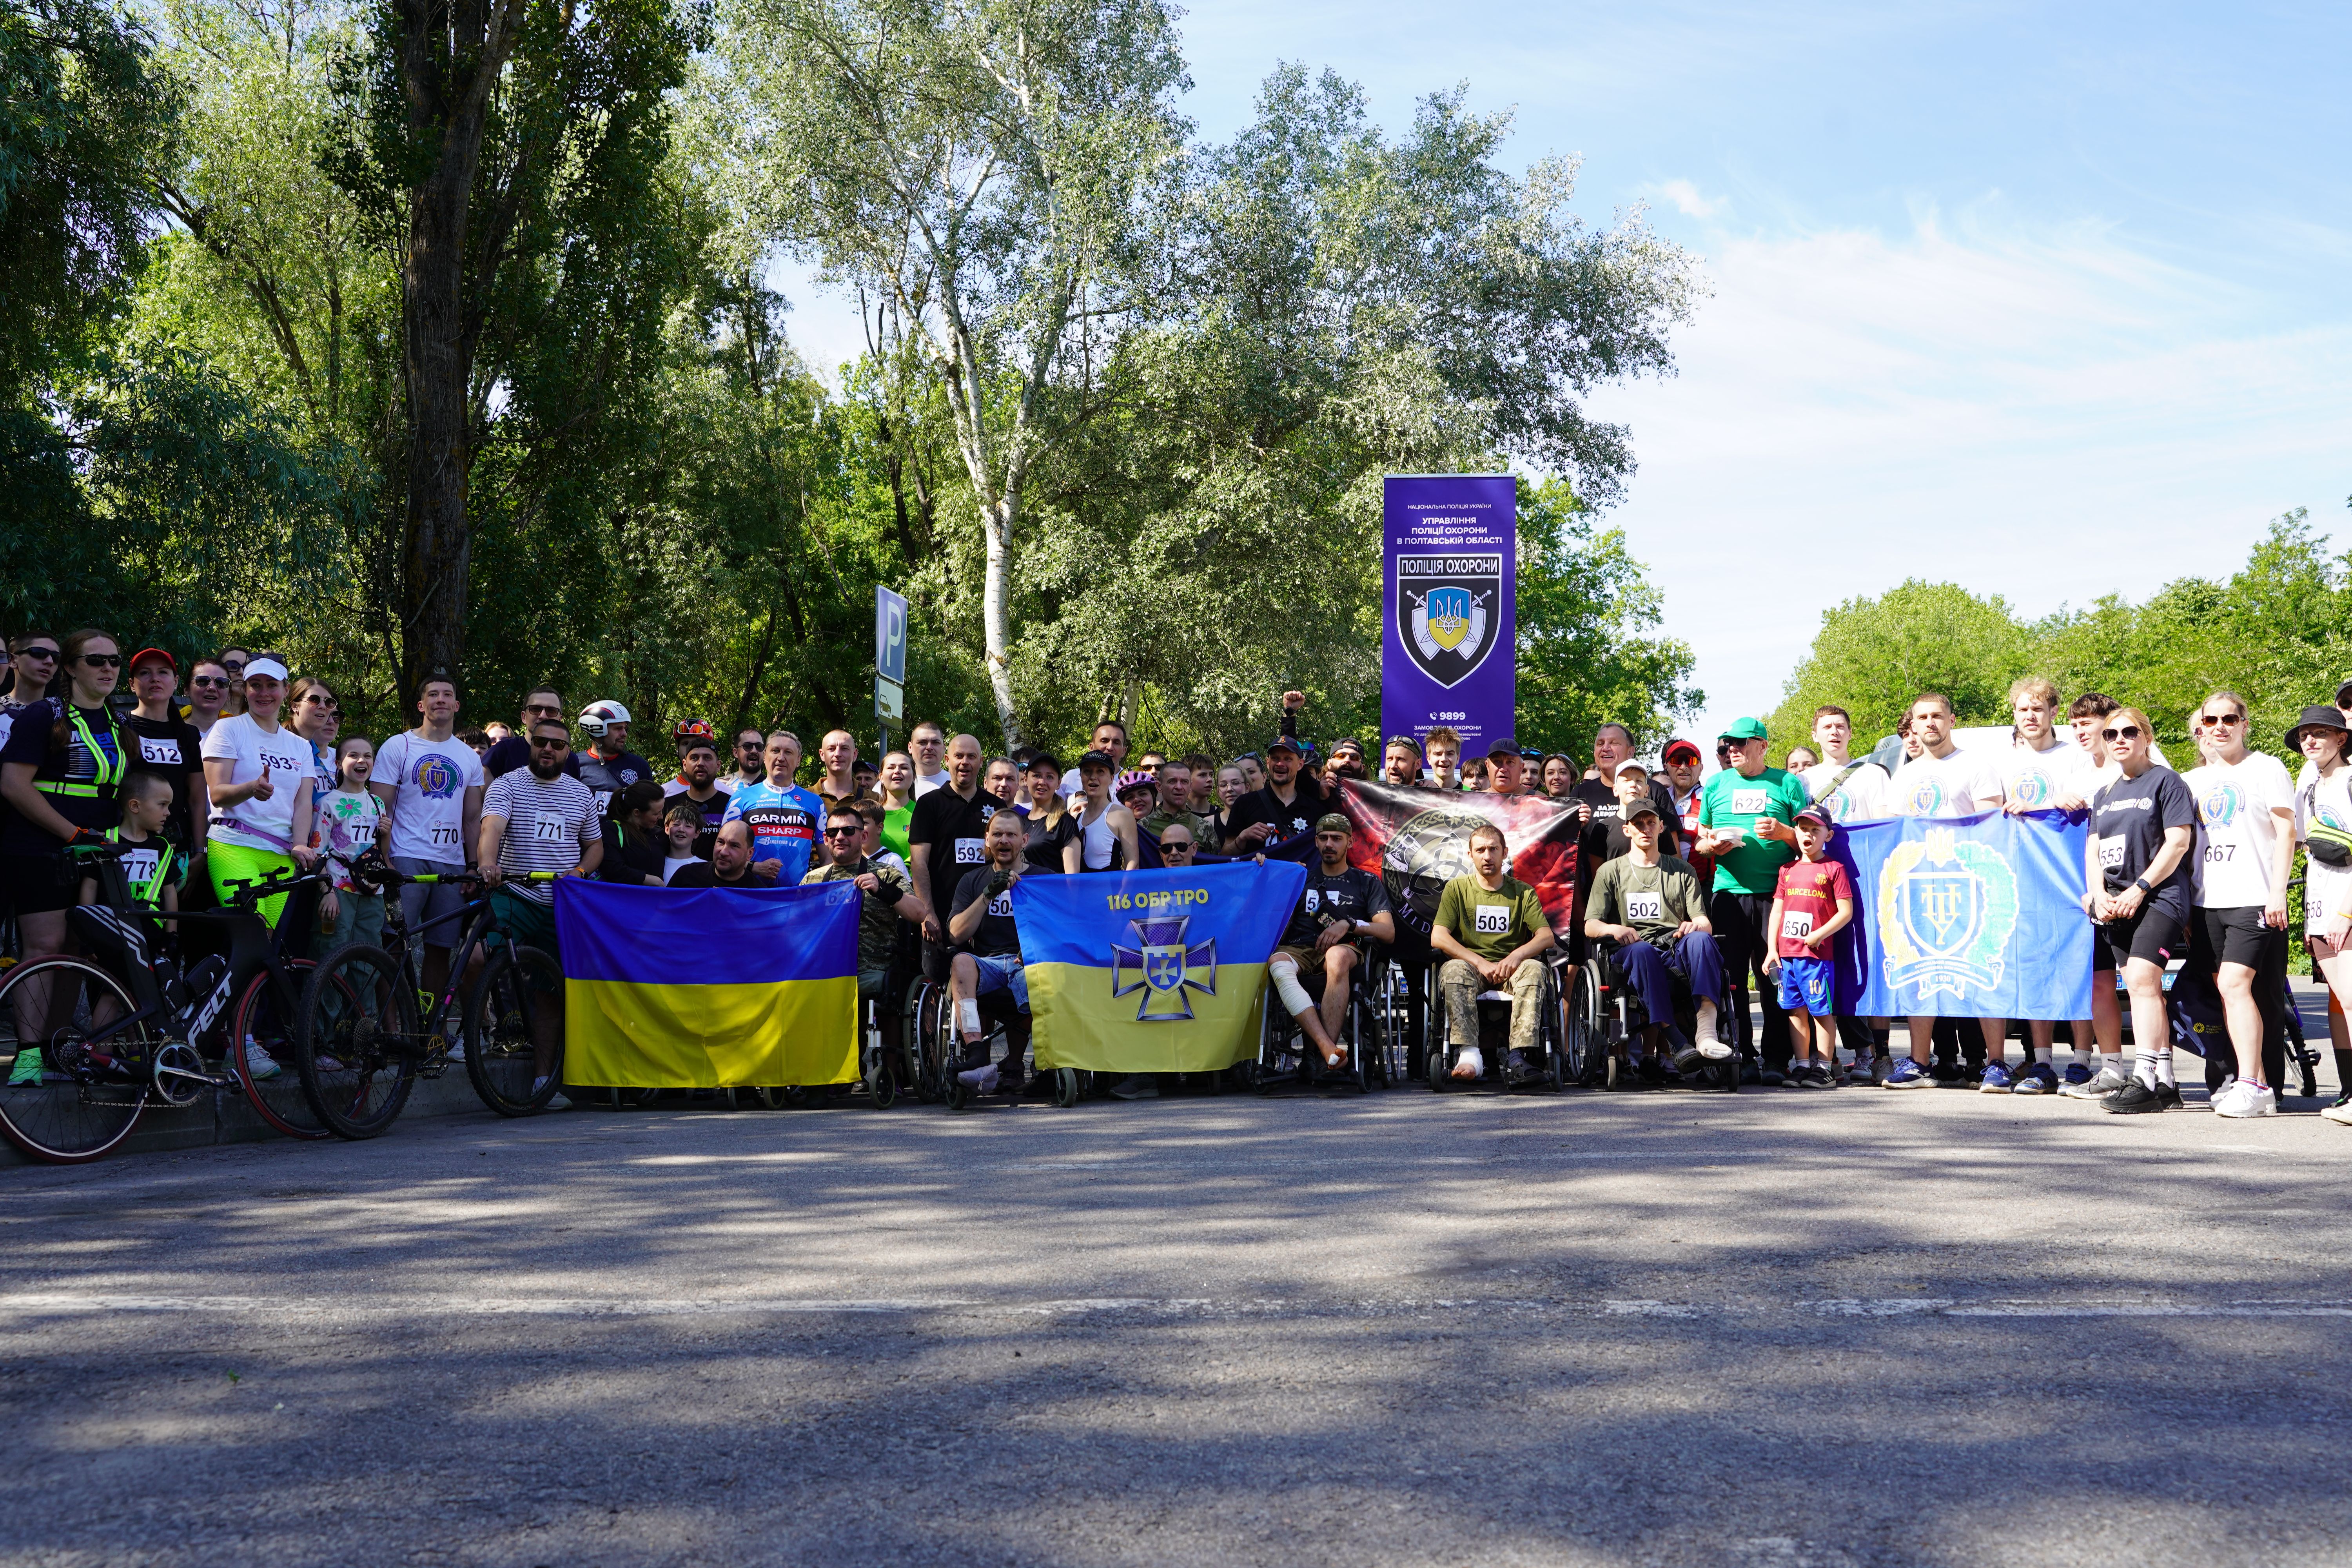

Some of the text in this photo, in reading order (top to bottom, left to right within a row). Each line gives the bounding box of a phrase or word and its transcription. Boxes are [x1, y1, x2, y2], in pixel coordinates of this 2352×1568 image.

[1412, 526, 1443, 535] ПОЛІЦІЇ
[1401, 559, 1497, 575] ПОЛІЦІЯ ОХОРОНИ
[887, 600, 902, 668] P
[1439, 711, 1466, 720] 9899
[144, 746, 180, 762] 512
[260, 753, 292, 770] 593
[1735, 798, 1763, 810] 622
[749, 814, 807, 825] GARMIN
[351, 825, 377, 841] 774
[431, 828, 458, 844] 770
[537, 822, 561, 839] 771
[757, 826, 802, 835] SHARP
[765, 837, 788, 846] BARRACUDA
[957, 847, 984, 862] 592
[2101, 847, 2123, 866] 553
[2205, 845, 2236, 862] 667
[123, 861, 157, 880] 778
[1107, 888, 1209, 910] 116 ОБР ТРО
[1787, 888, 1827, 899] BARCELONA
[1630, 902, 1659, 917] 502
[2306, 900, 2322, 919] 658
[1477, 915, 1507, 931] 503
[1785, 921, 1809, 937] 650
[1809, 979, 1821, 995] 10
[187, 970, 232, 1049] FELT
